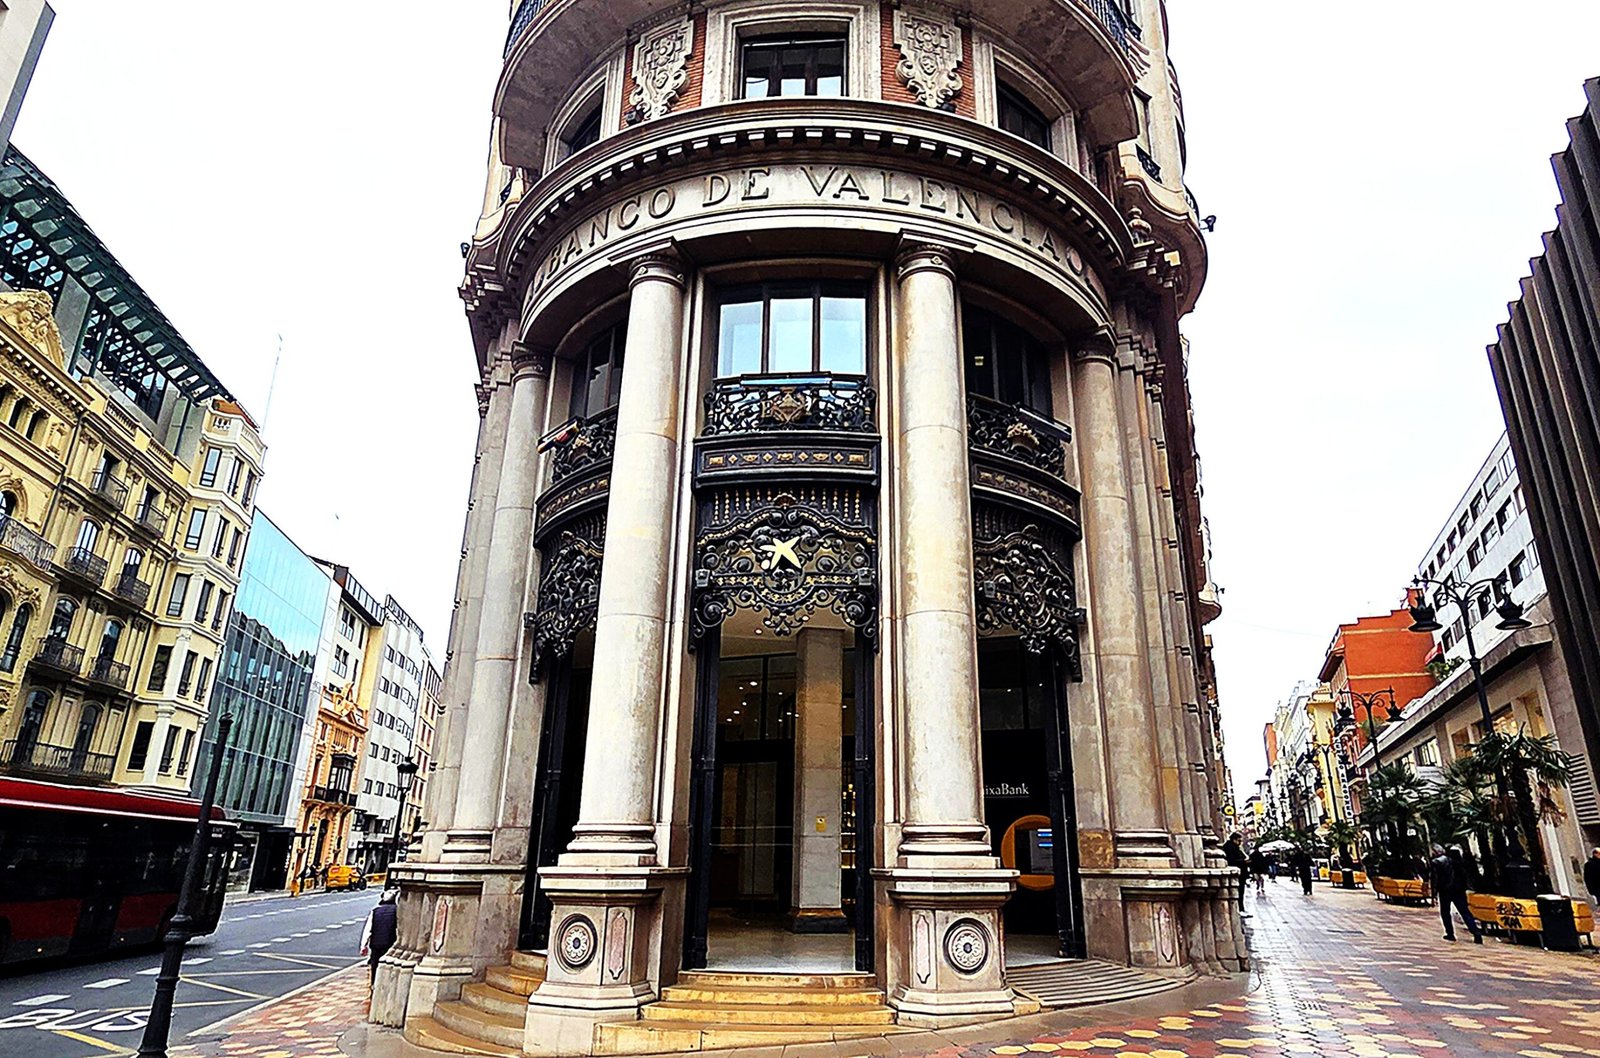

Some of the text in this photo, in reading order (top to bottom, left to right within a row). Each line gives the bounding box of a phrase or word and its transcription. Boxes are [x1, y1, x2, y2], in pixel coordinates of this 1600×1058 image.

[547, 166, 1061, 279] BANCO DE VALENCIA
[985, 783, 1029, 795] ixaBank
[0, 1008, 151, 1031] BUS
